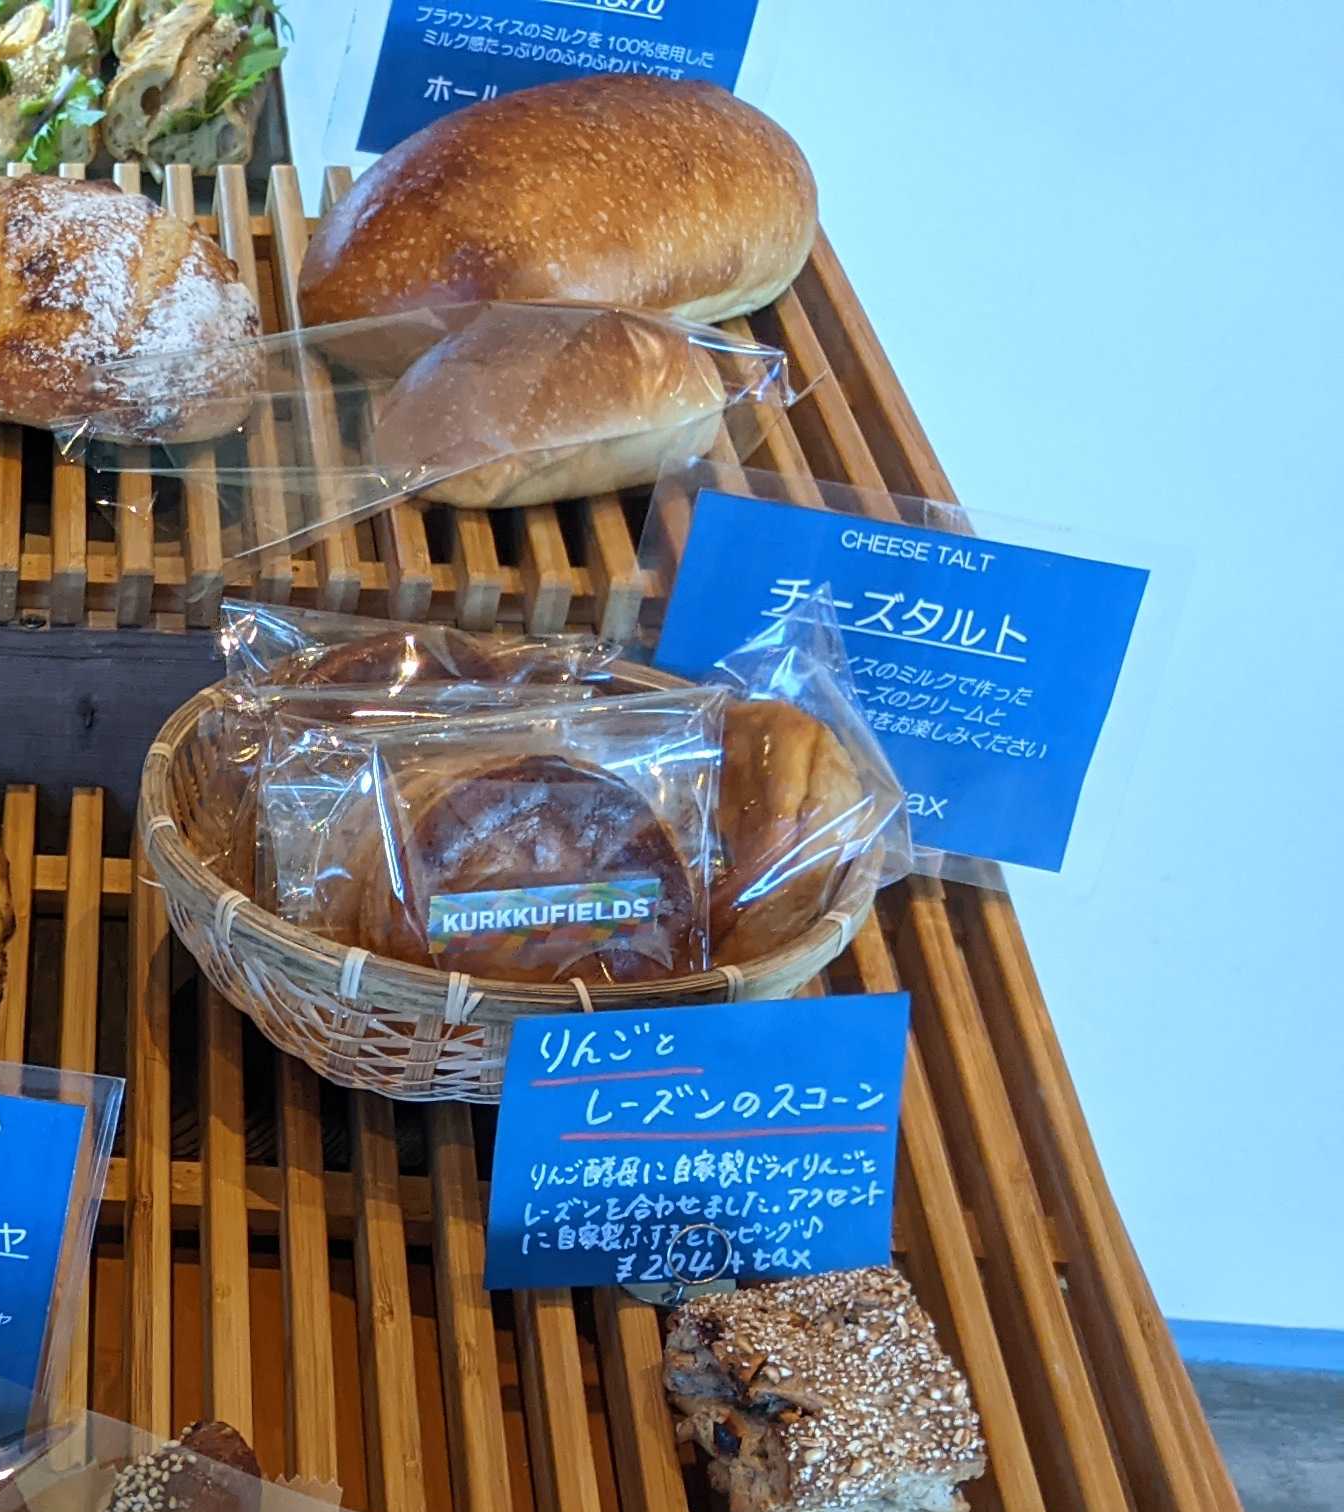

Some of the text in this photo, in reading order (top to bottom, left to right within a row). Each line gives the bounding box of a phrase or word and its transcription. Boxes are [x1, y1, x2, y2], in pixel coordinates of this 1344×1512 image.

[840, 529, 996, 574] CHEESE TALT
[768, 577, 1029, 655] チーズタルト
[903, 791, 949, 819] ax
[442, 897, 650, 933] KURKKUFIELDS
[538, 1021, 677, 1074] りんごと
[584, 1081, 886, 1128] レーズンのスコーン
[751, 1247, 814, 1273] tax
